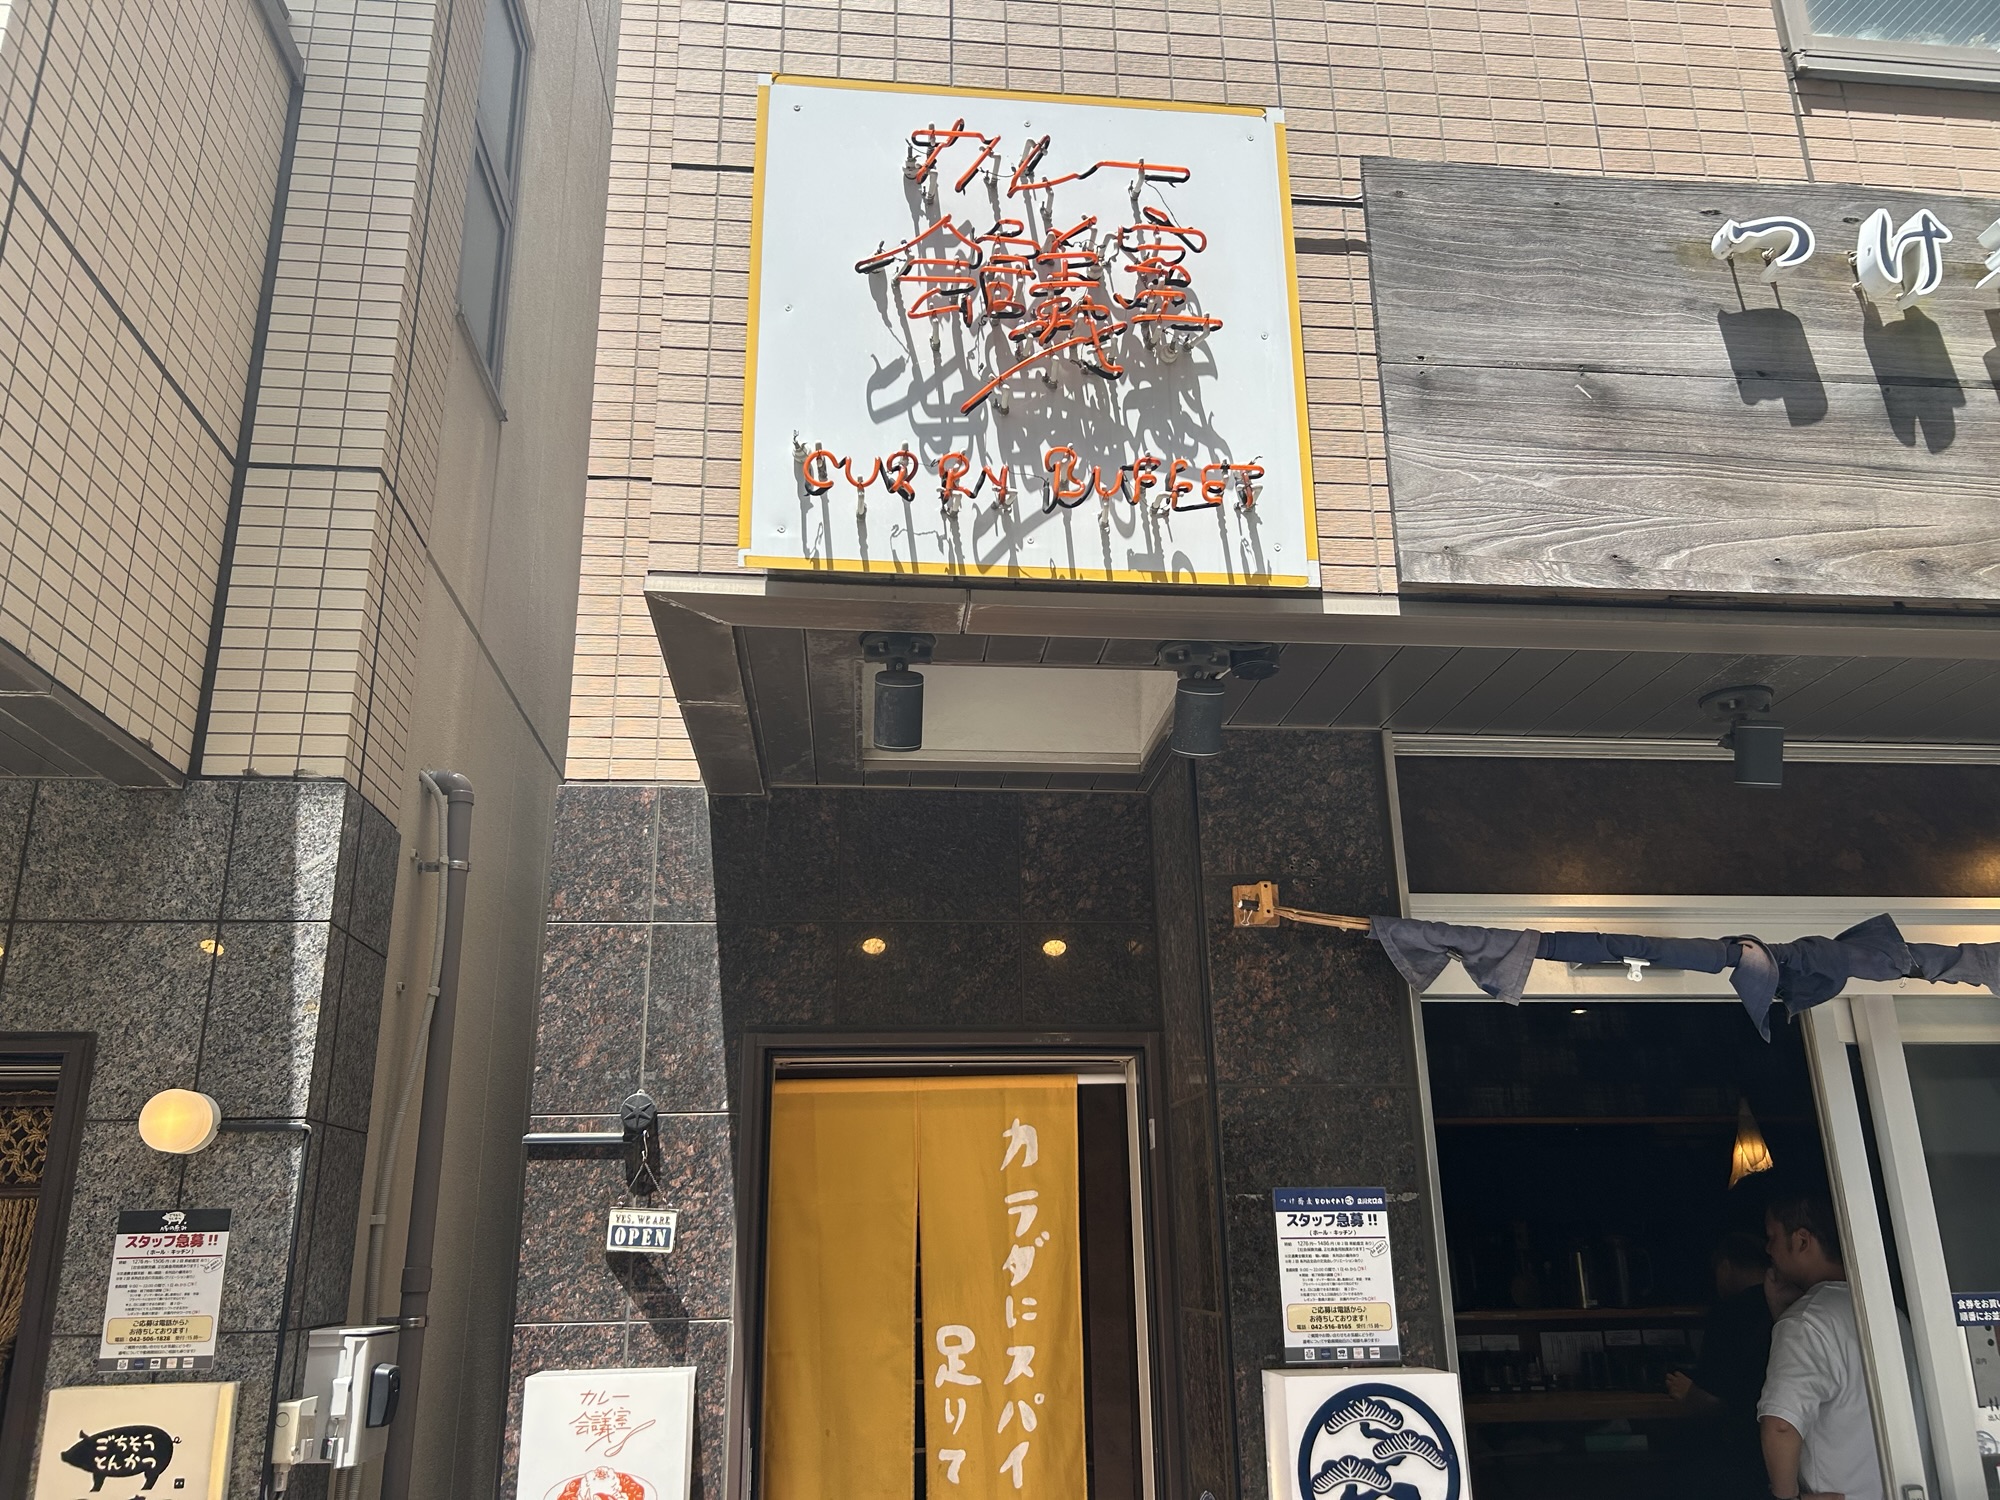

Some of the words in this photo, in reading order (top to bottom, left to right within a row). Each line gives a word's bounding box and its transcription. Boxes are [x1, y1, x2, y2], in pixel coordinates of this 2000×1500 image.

[910, 117, 1191, 198] カレー
[1711, 208, 2000, 310] つけ
[854, 206, 1224, 415] 会議室
[802, 444, 1010, 503] CURRY
[1042, 445, 1265, 513] BUFFET
[614, 1226, 667, 1247] OPEN
[637, 1214, 651, 1225] WE
[652, 1215, 671, 1226] ARE
[998, 1117, 1050, 1489] カラダにスパイ
[580, 1389, 630, 1406] カレー
[935, 1324, 982, 1484] 足りて
[95, 1433, 156, 1452] ごちそう
[568, 1407, 632, 1453] 会議室
[94, 1453, 157, 1471] とんかつ
